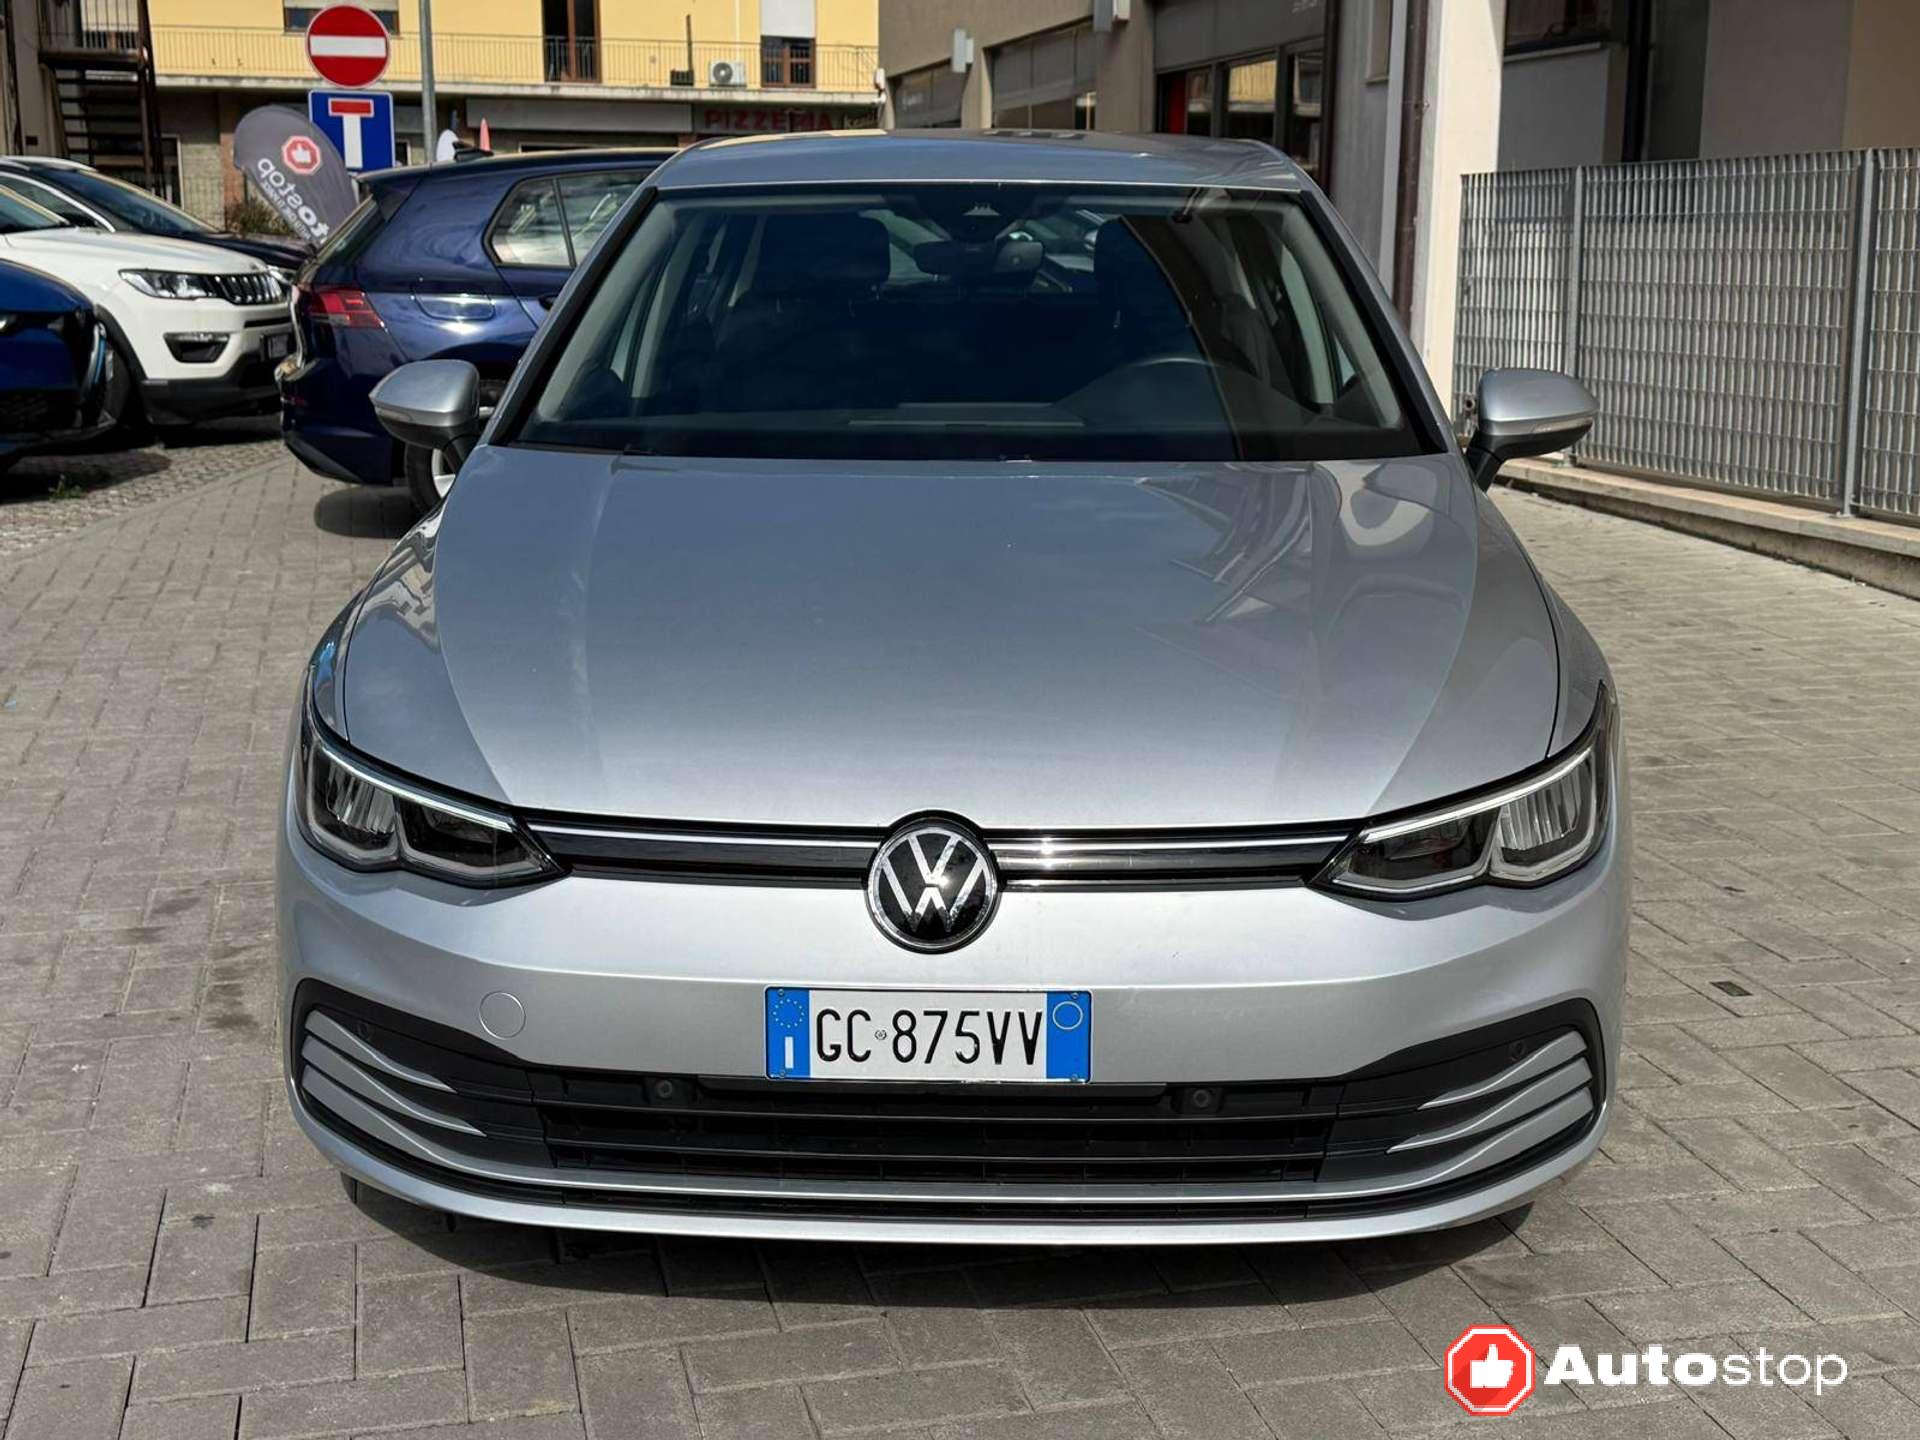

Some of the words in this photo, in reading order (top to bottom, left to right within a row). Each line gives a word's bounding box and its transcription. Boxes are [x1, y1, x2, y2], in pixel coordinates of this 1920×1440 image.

[874, 828, 990, 935] VW
[816, 1008, 872, 1063] GC
[891, 1009, 1043, 1066] 875VV
